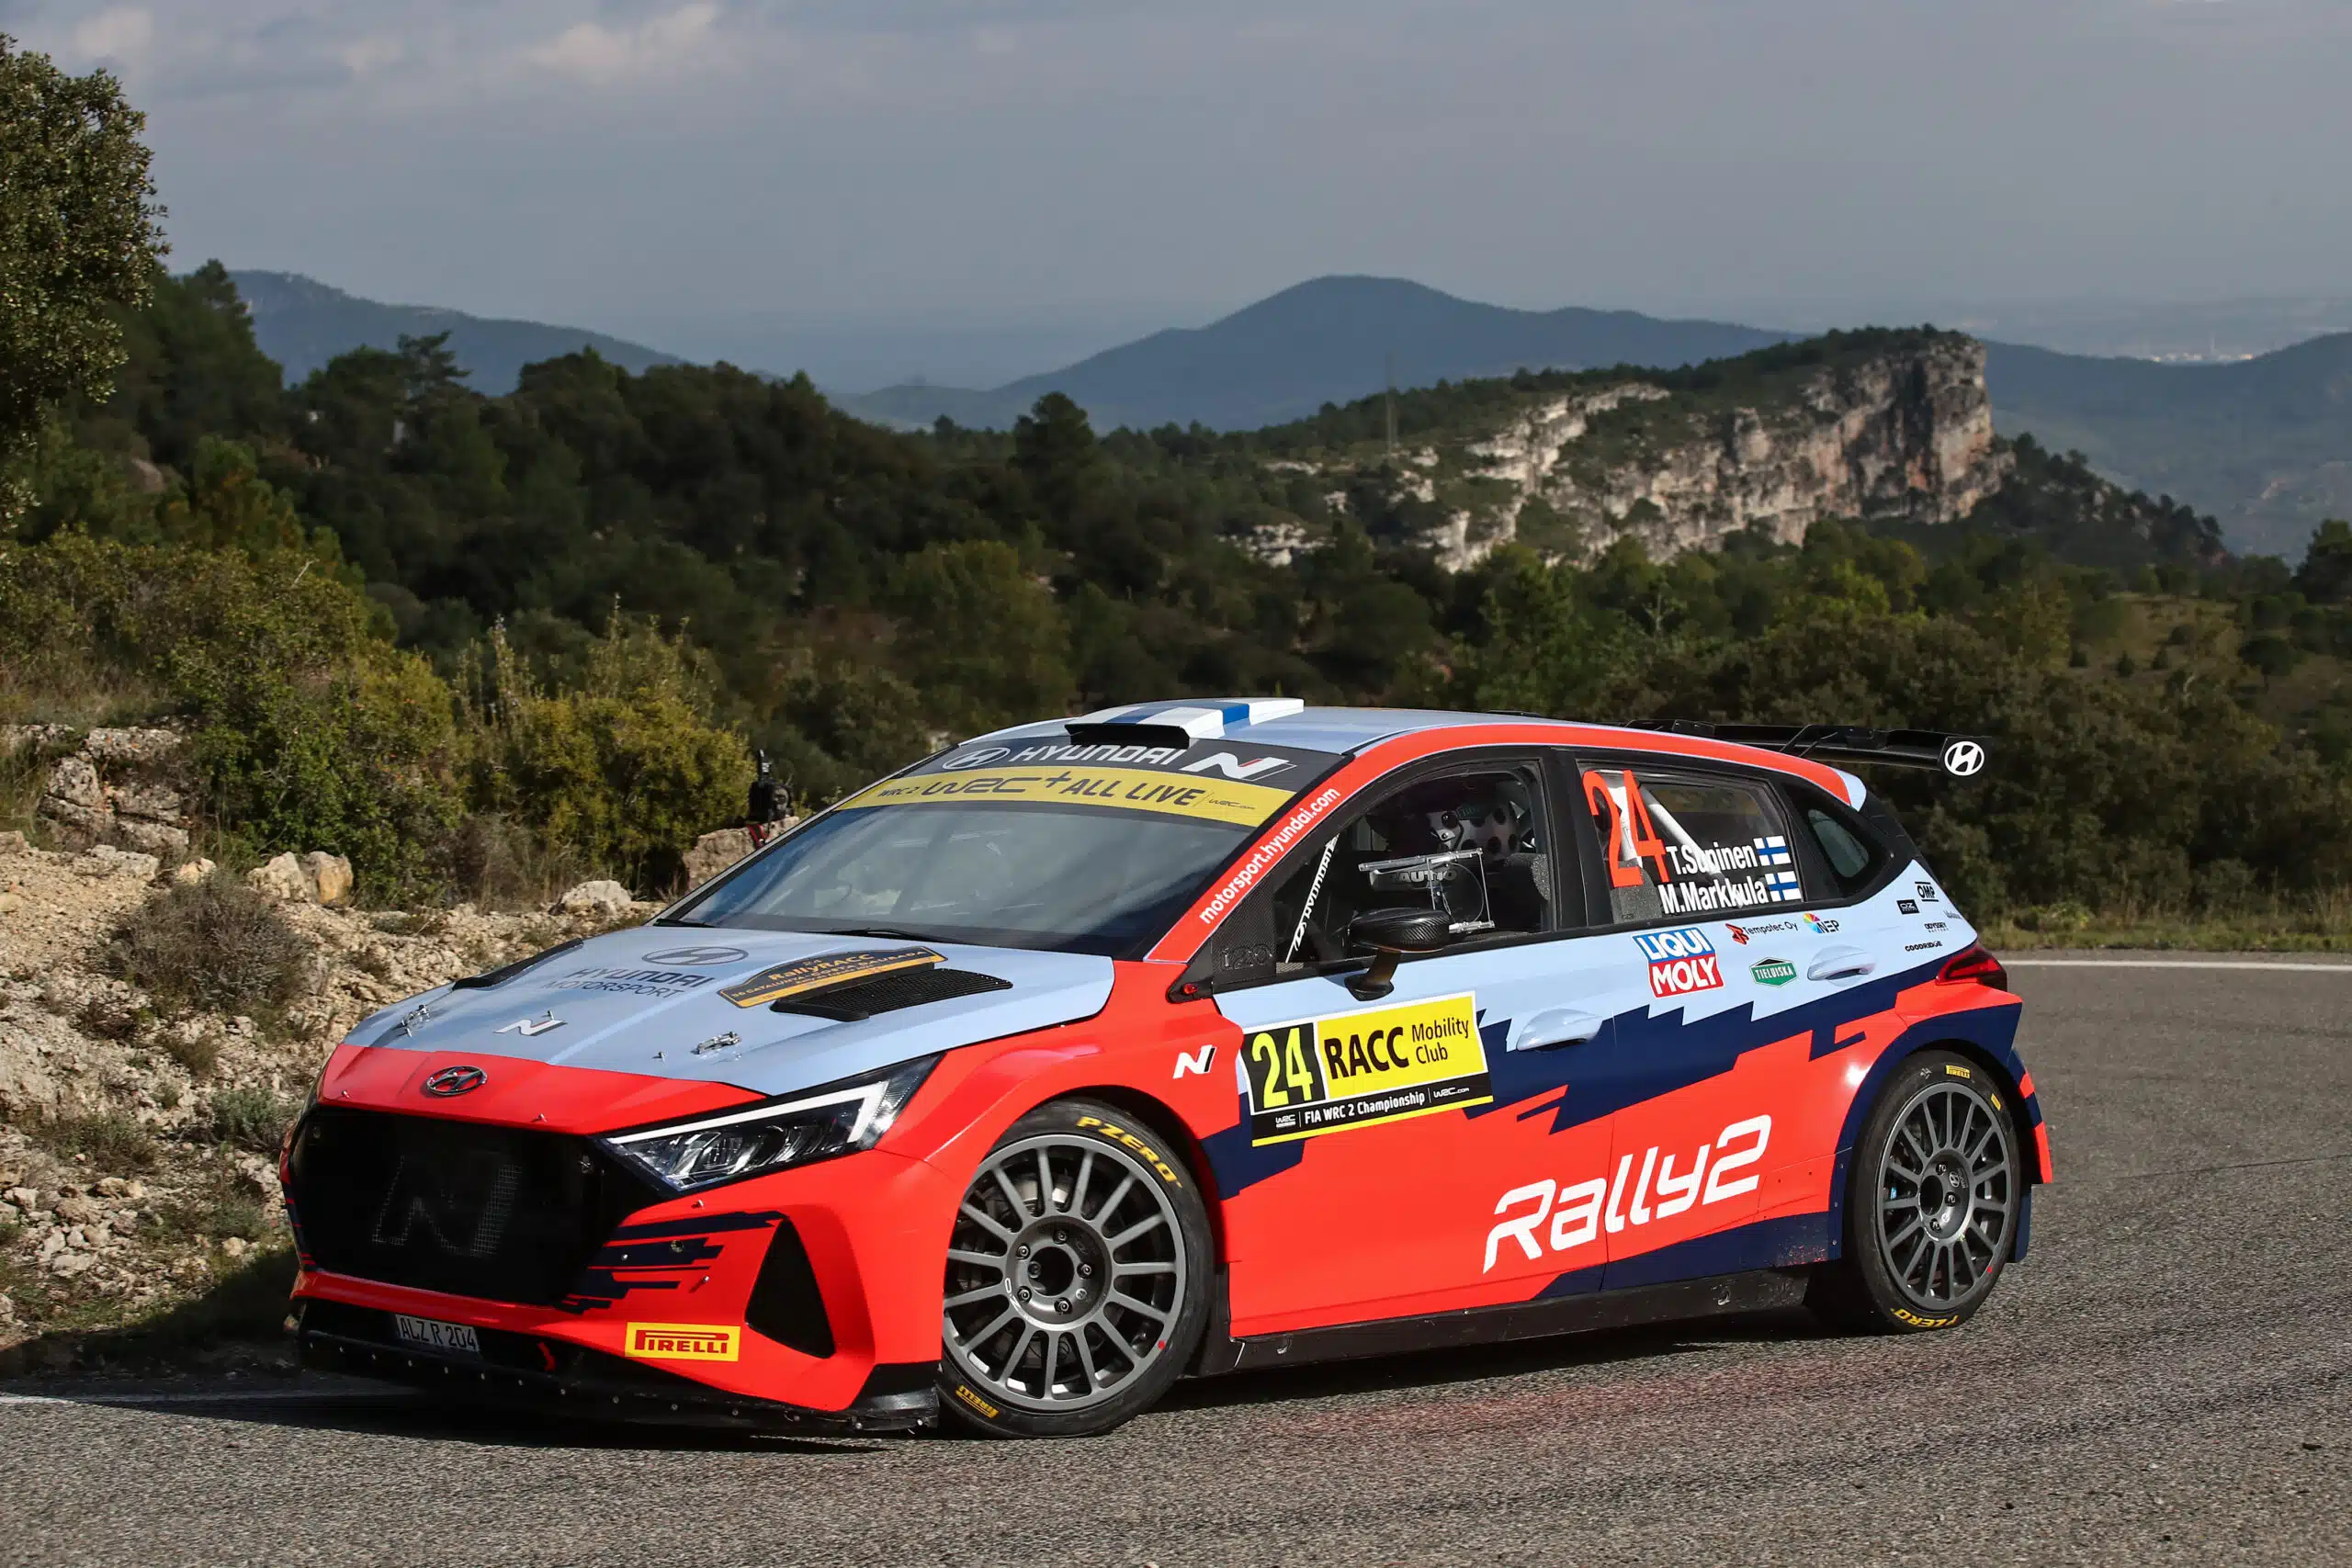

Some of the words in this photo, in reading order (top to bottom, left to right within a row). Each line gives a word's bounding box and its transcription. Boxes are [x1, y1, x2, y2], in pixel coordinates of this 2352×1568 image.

[1009, 744, 1188, 765] HYUNDAI
[1058, 778, 1118, 797] ALL
[1125, 782, 1207, 807] LIVE
[1582, 769, 1670, 887] 24
[1199, 788, 1341, 924] motorsport.hyundai.com
[1657, 875, 1769, 915] M.Markkula
[1917, 885, 1936, 898] OMP
[1785, 920, 1798, 931] Oy
[1636, 929, 1713, 961] LIQUI
[1905, 941, 1943, 952] GOODRIDGE
[564, 968, 716, 987] HYUNDAI
[768, 953, 876, 982] RallyRACC
[1652, 956, 1717, 995] MOLY
[1755, 965, 1794, 980] TIELUISKA
[540, 981, 685, 998] MOTORSPORT
[1251, 1027, 1314, 1109] 24
[1324, 1026, 1409, 1079] RACC
[1411, 1016, 1470, 1043] Mobility
[1416, 1043, 1448, 1064] Club
[1946, 1066, 1970, 1078] PIRELLI
[1305, 1110, 1321, 1124] FIA
[1323, 1105, 1347, 1122] WRC
[1348, 1103, 1355, 1116] 2
[1357, 1091, 1425, 1115] Championship
[1483, 1114, 1771, 1274] Rally2
[400, 1317, 429, 1341] ALZ
[430, 1323, 443, 1345] R
[446, 1325, 476, 1349] 204
[634, 1329, 729, 1354] PIRELLI
